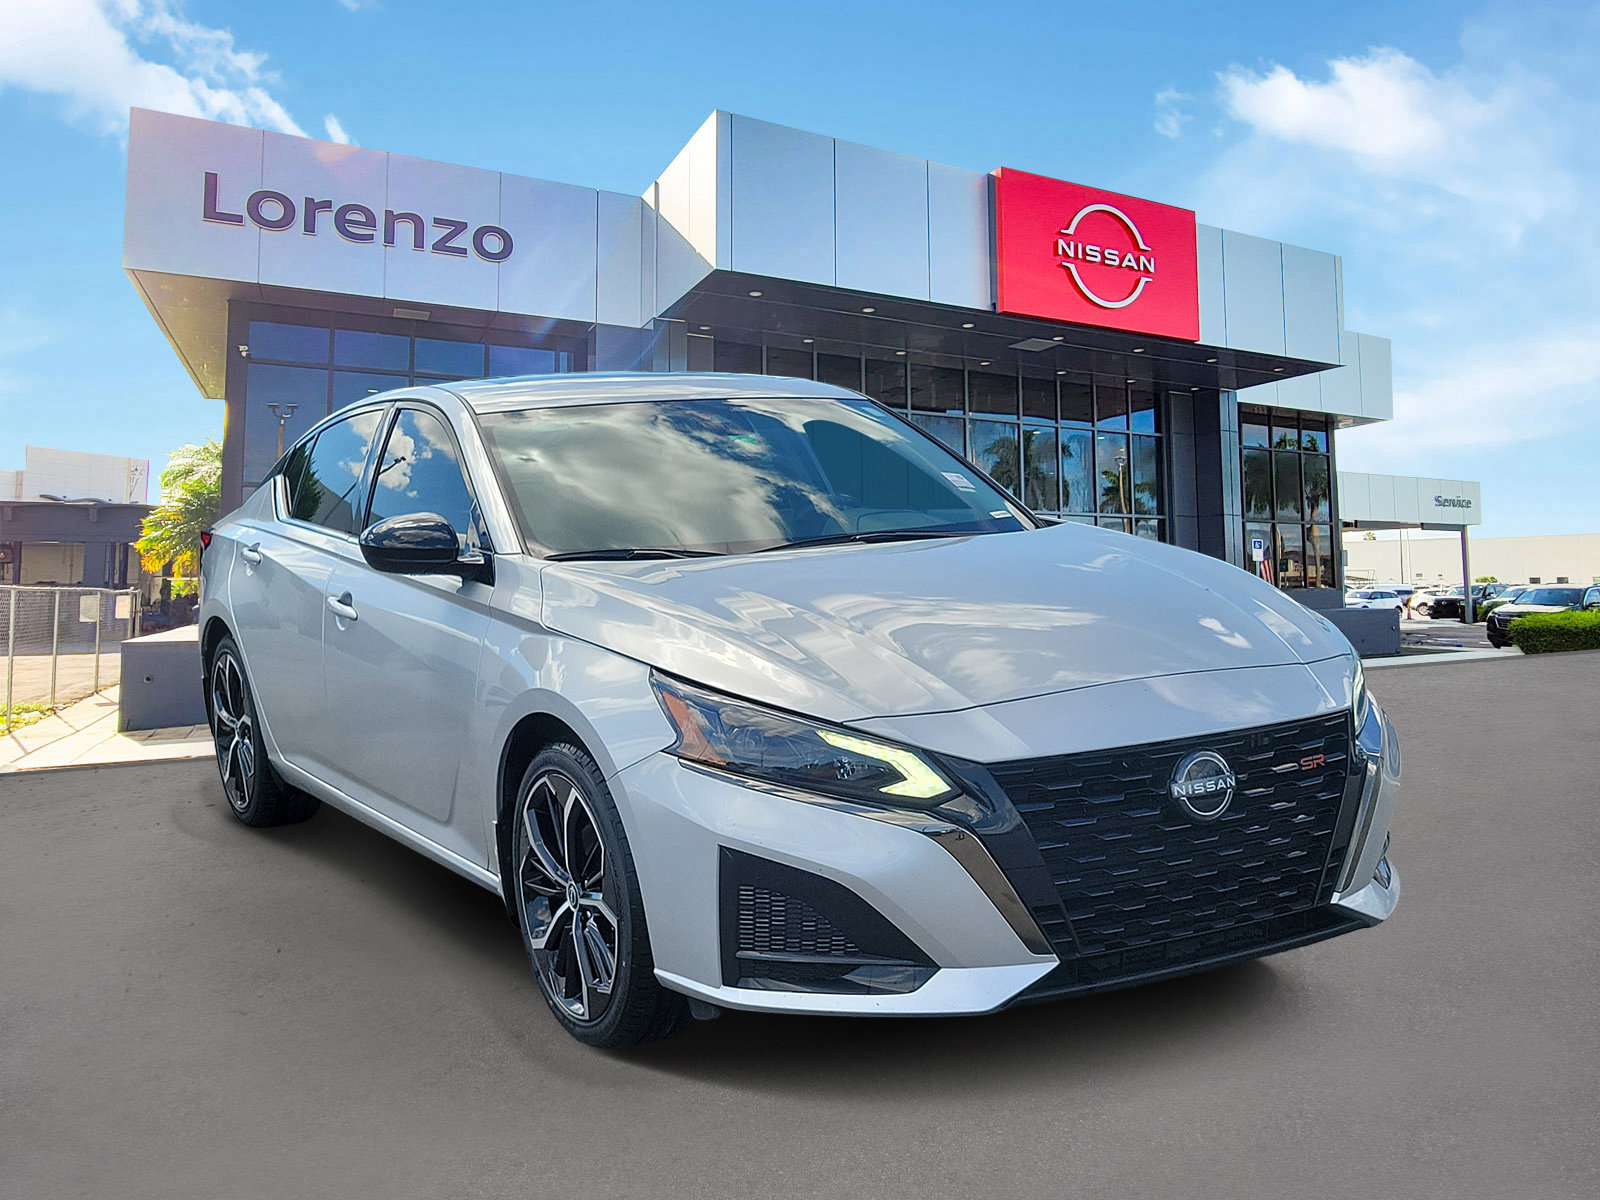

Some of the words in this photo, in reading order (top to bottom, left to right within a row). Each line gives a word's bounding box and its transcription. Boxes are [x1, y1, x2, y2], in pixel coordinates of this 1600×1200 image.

[202, 171, 514, 262] Lorenzo
[1057, 238, 1155, 273] NISSAN
[1434, 495, 1472, 508] Service
[1300, 753, 1325, 770] SR
[1173, 775, 1236, 797] NISSAN
